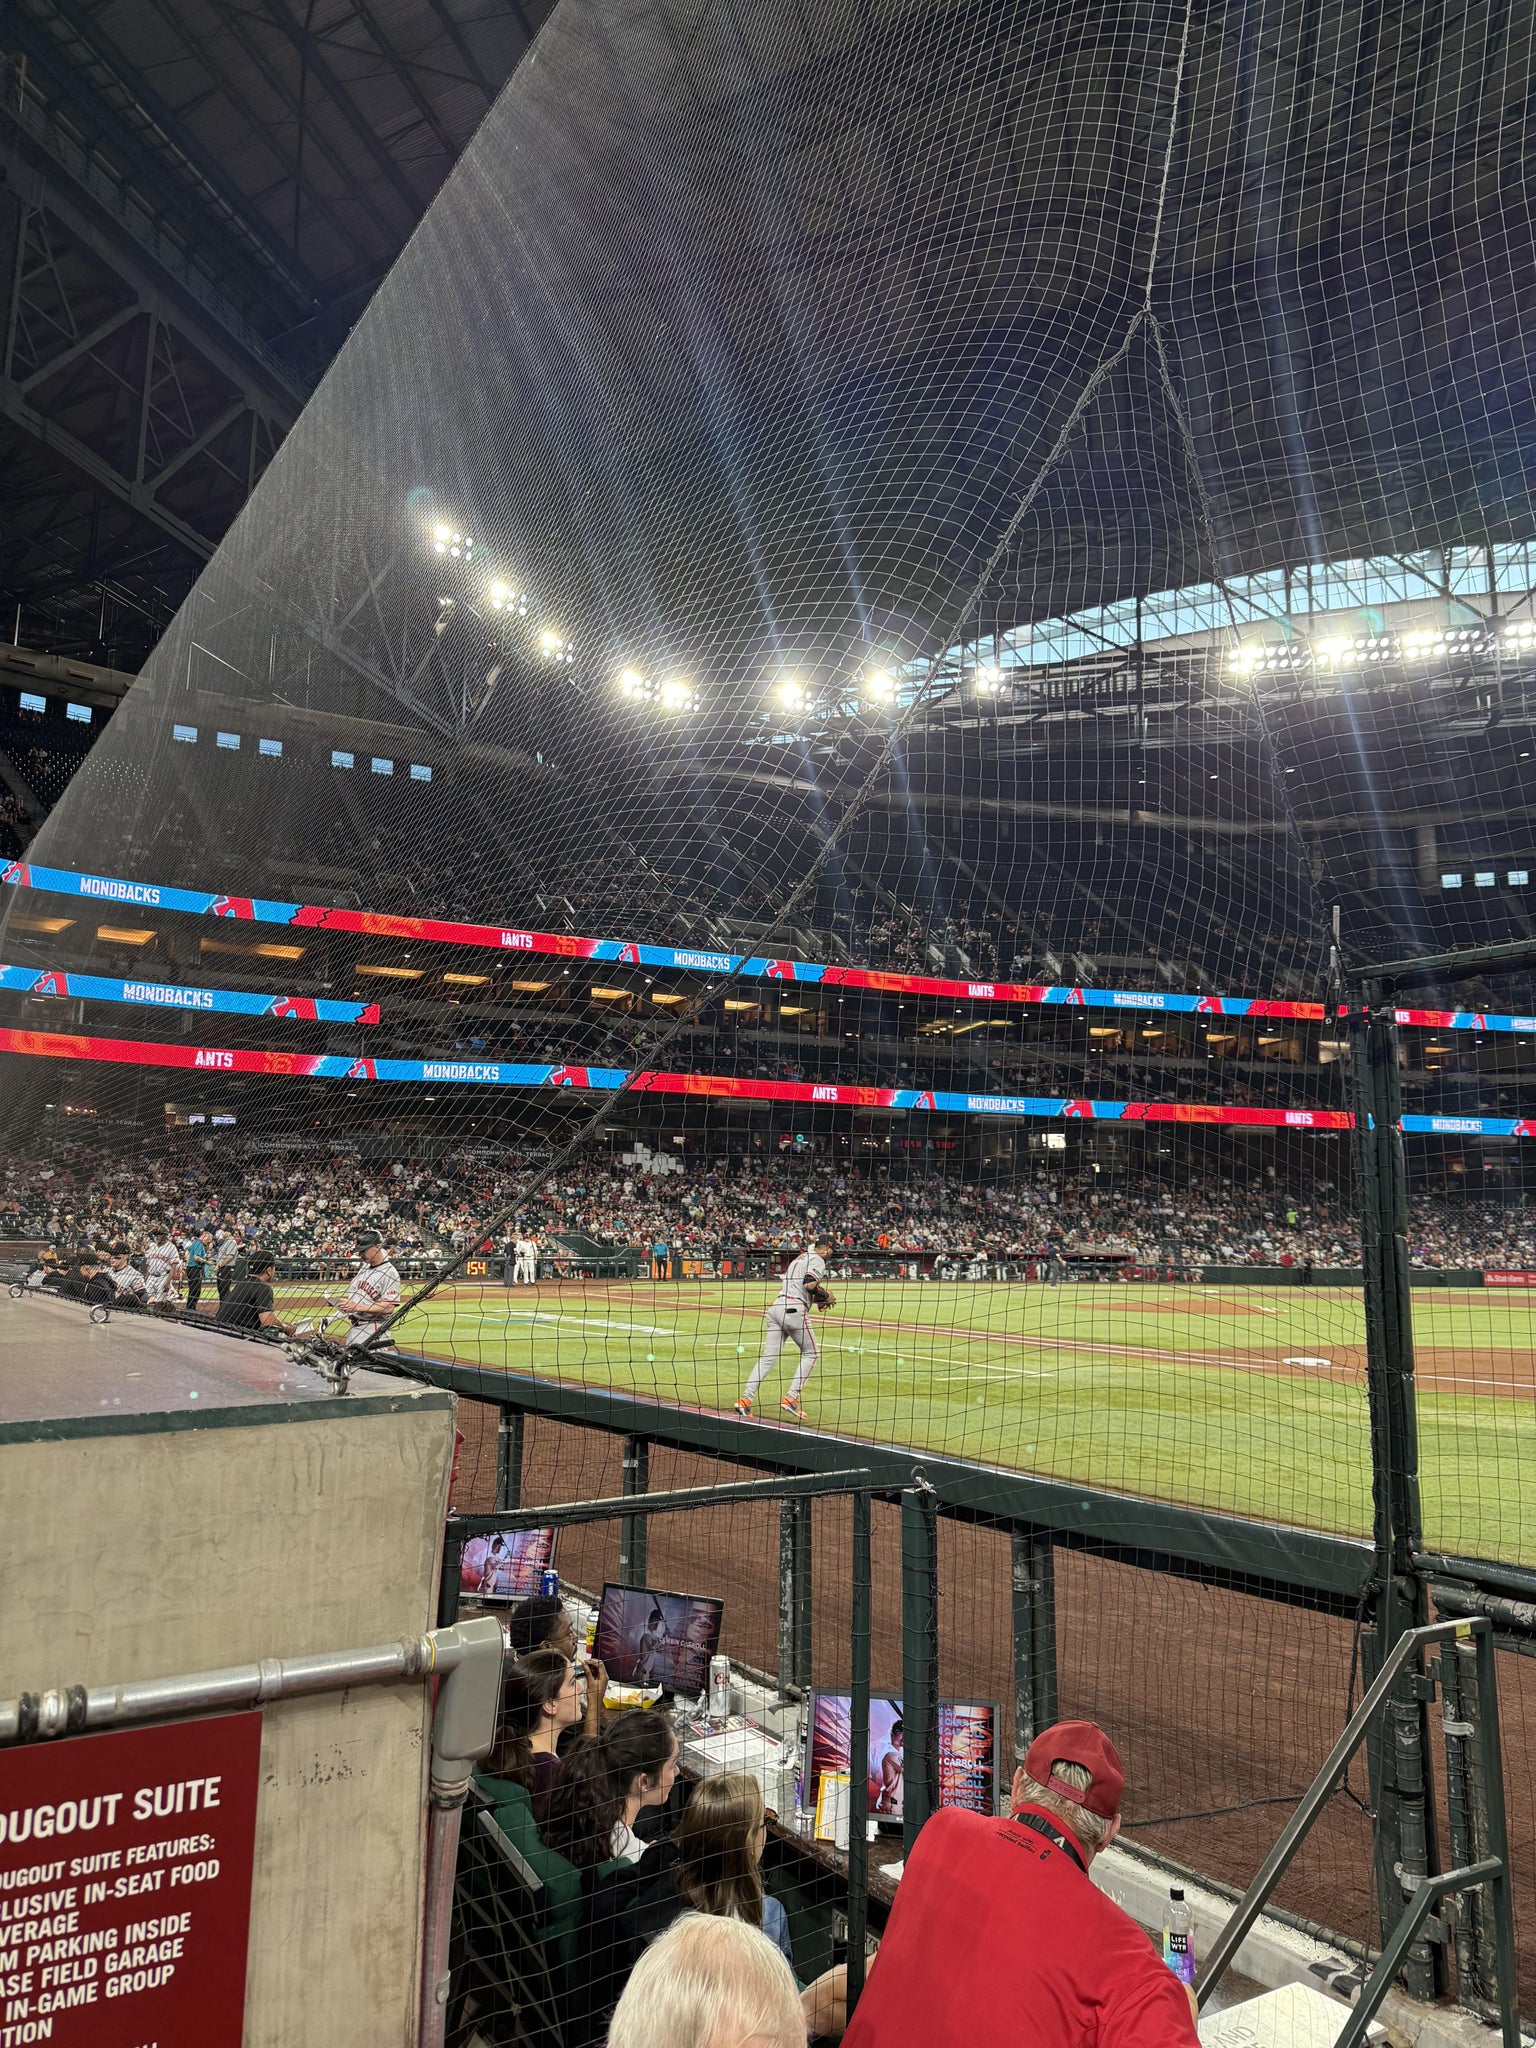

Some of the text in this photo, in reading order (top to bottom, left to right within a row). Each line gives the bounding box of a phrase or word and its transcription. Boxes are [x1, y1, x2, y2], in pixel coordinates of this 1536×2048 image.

[80, 877, 160, 904] MONDBACKS
[501, 931, 533, 948] IANTS
[674, 951, 730, 970] MONDBACKS
[123, 983, 213, 1008] MONDBACKS
[968, 984, 995, 997] IANTS
[1113, 993, 1164, 1007] MONDBACKS
[195, 1051, 234, 1068] ANTS
[423, 1064, 499, 1081] MONDBACKS
[812, 1087, 838, 1101] ANTS
[967, 1096, 1025, 1112] MONDBACKS
[1432, 1119, 1482, 1131] MONDBACKS
[466, 1261, 486, 1276] 154
[944, 1758, 985, 1769] CARROLL
[133, 1776, 221, 1820] SUITE
[0, 1834, 215, 1891] UGOUT SUITE FEATURES:
[0, 1859, 220, 1922] LUSIVE IN-SEAT FOOD
[26, 1928, 118, 1967] PARKING
[125, 1912, 192, 1945] INSIDE
[1171, 1935, 1186, 1943] LIFE
[1171, 1943, 1187, 1951] WTR
[41, 1957, 98, 1989] FIELD
[105, 1937, 184, 1974] GARAGE
[6, 1964, 175, 2022] IN-GAME GROUP
[0, 2017, 53, 2048] TION
